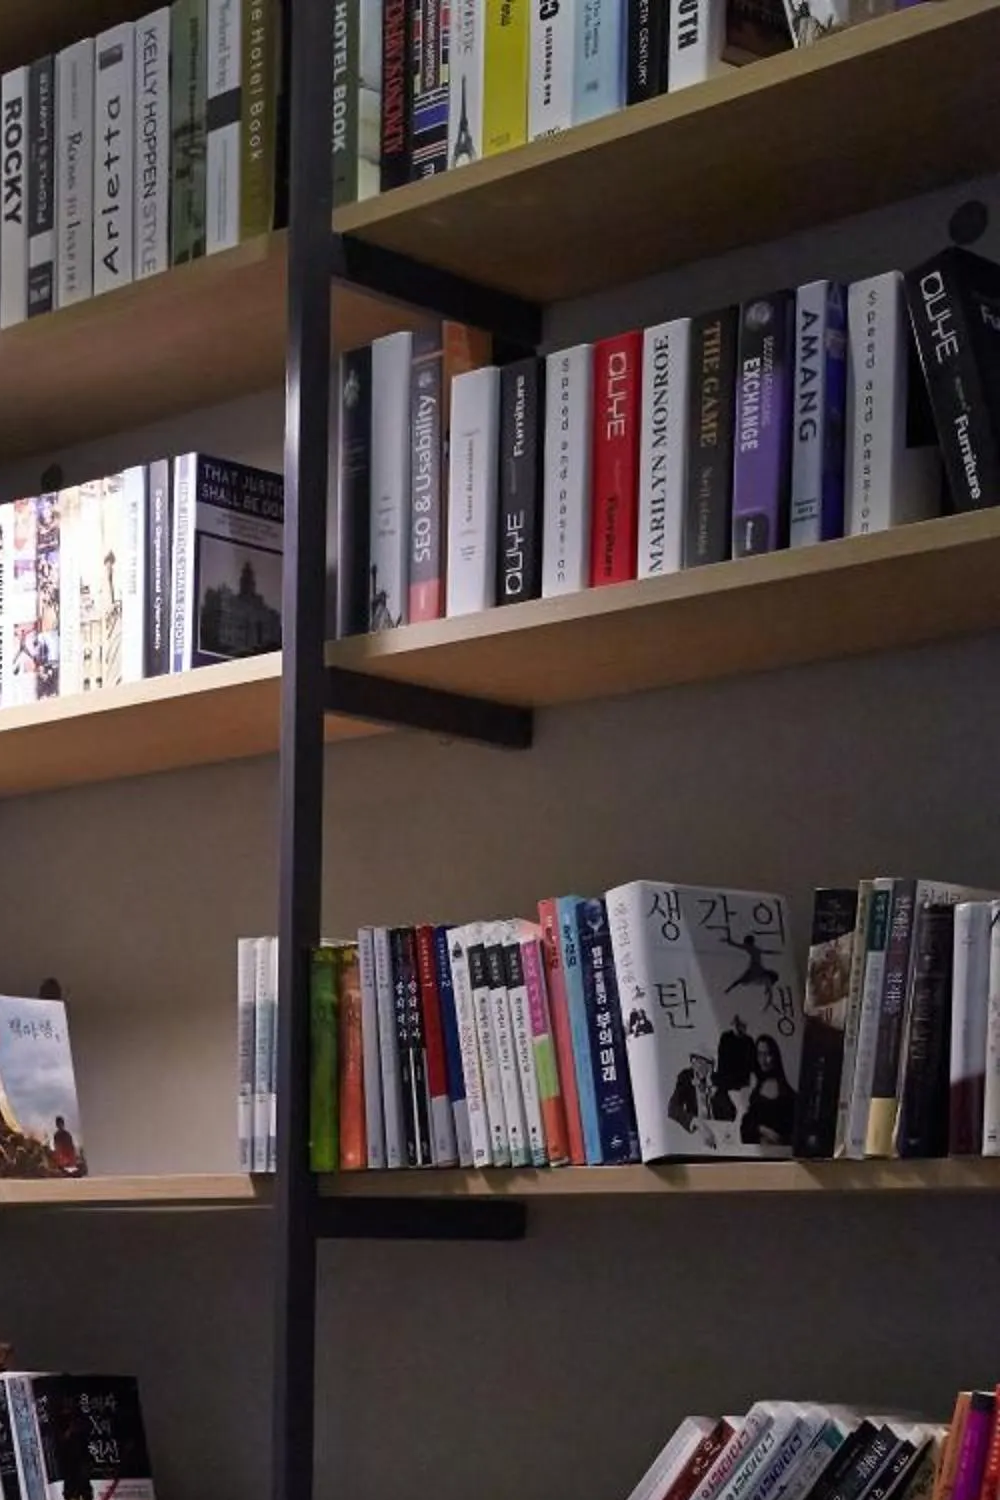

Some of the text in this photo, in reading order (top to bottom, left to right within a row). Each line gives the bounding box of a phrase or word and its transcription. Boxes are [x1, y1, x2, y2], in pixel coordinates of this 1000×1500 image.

[250, 28, 265, 95] Hotel
[332, 1, 347, 153] HOTEL BOOK
[4, 97, 23, 226] ROCKY
[141, 28, 158, 274] KELLY HOPPEN STYLE
[249, 104, 264, 162] Book
[101, 95, 121, 276] Arletta
[702, 321, 721, 372] THE
[798, 309, 819, 443] AMANG
[511, 375, 526, 458] Furniture
[699, 377, 719, 448] GAME
[740, 356, 761, 453] EXCHANGE
[203, 463, 238, 485] THAT
[414, 395, 437, 564] SEO & Usability
[648, 335, 670, 574] MARILYN MONROE
[954, 415, 983, 500] Furniture
[648, 889, 786, 954] 생각의
[654, 978, 796, 1037] 탄생
[87, 1439, 121, 1464] 헌신
